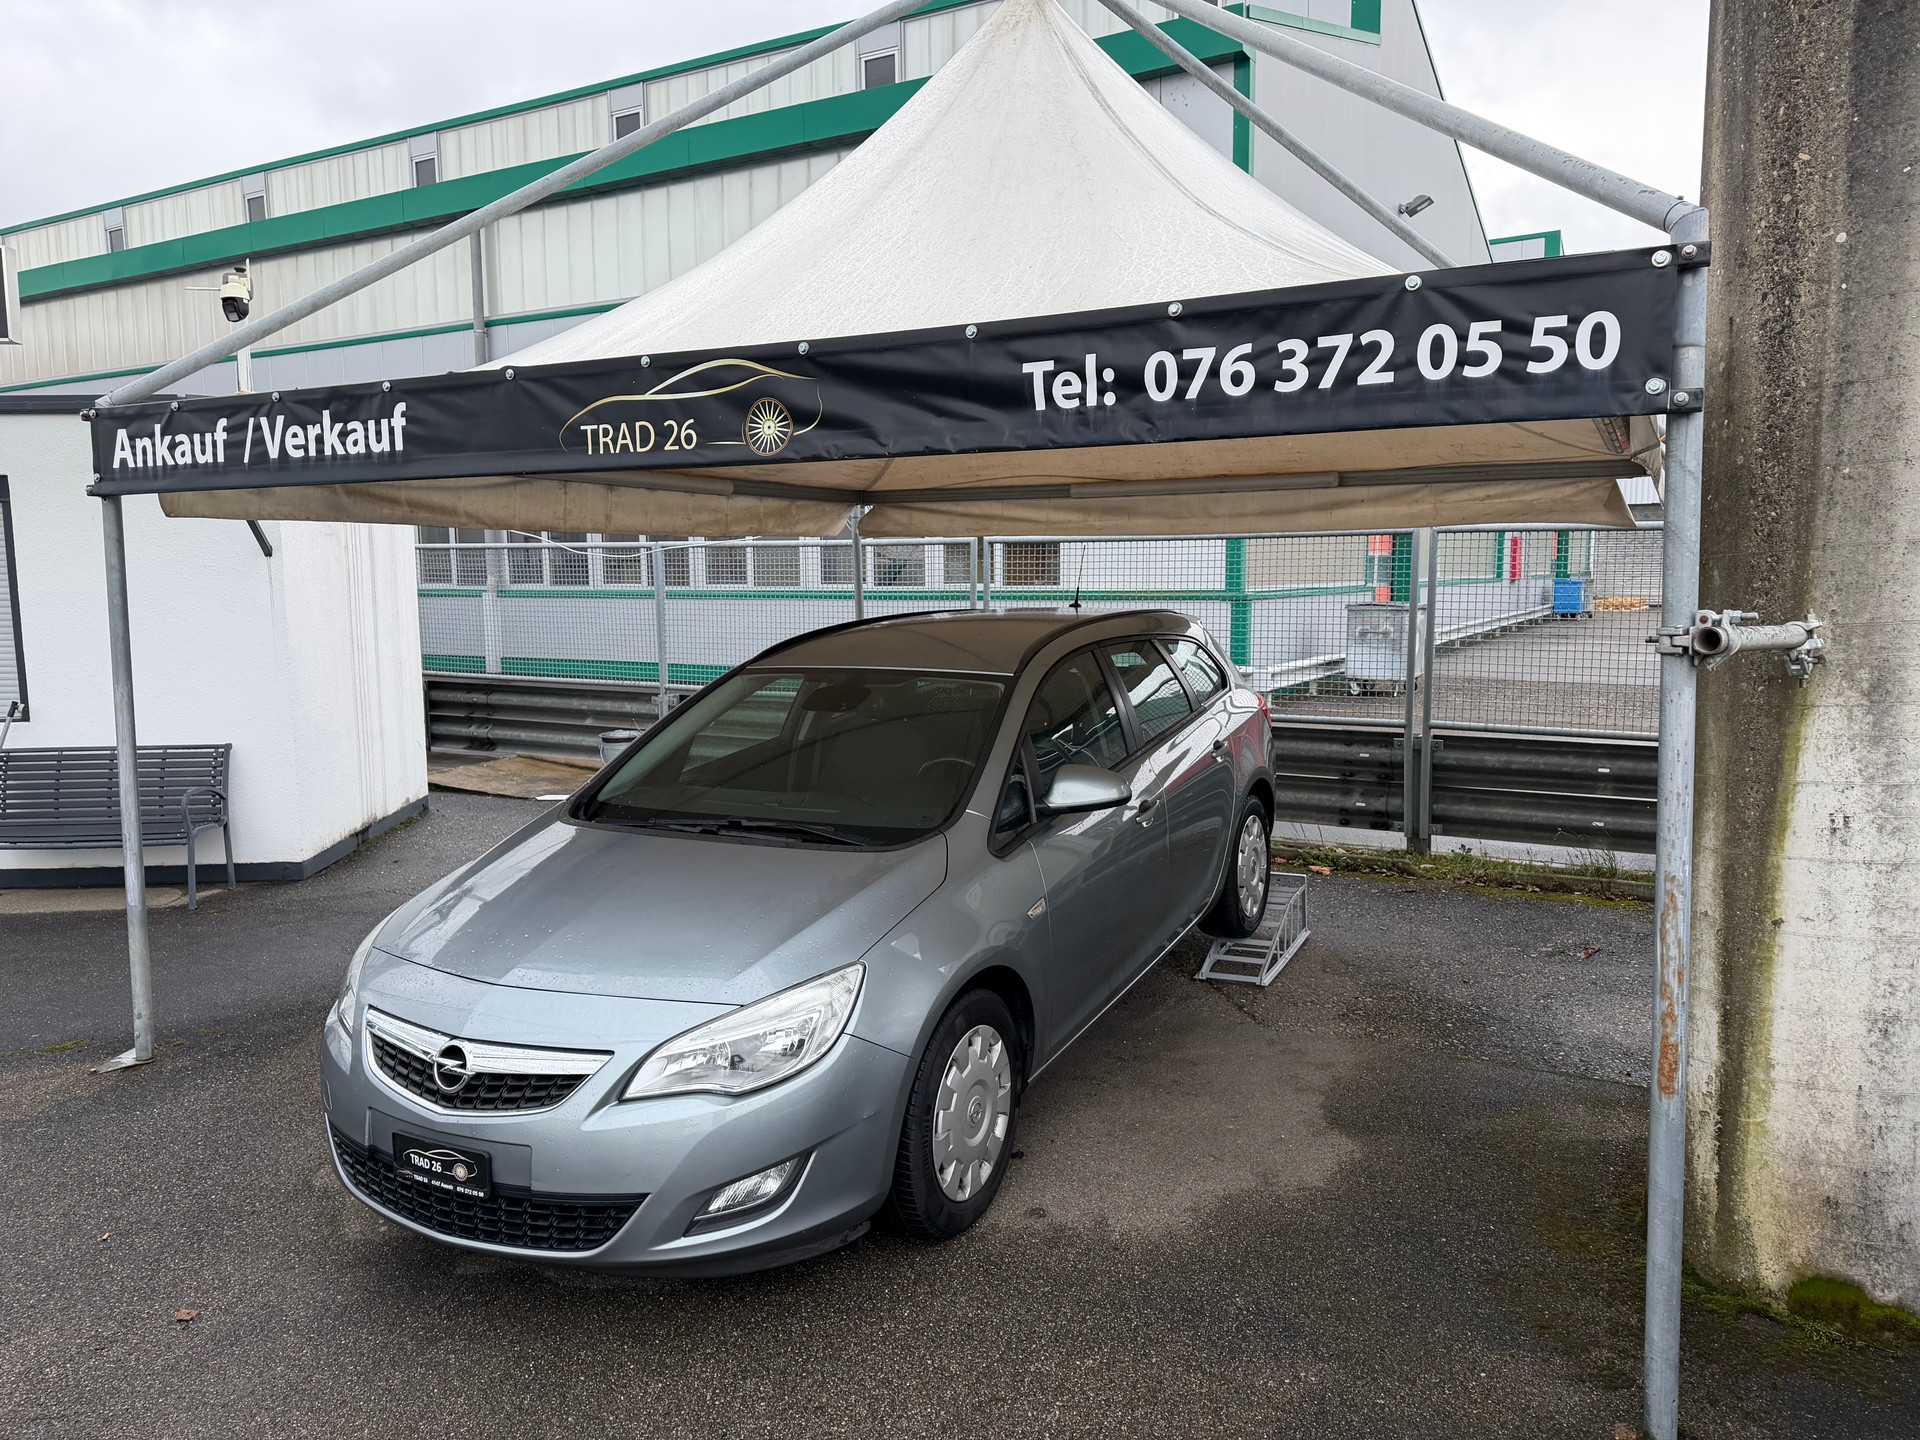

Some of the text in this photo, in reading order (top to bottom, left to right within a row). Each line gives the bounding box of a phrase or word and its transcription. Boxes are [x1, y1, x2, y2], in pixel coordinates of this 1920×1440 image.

[1022, 310, 1622, 412] Tel: 076 372 05 50
[112, 417, 228, 471] Ankauf
[579, 419, 698, 456] TRAD 26
[409, 1153, 442, 1173] TRAD 26
